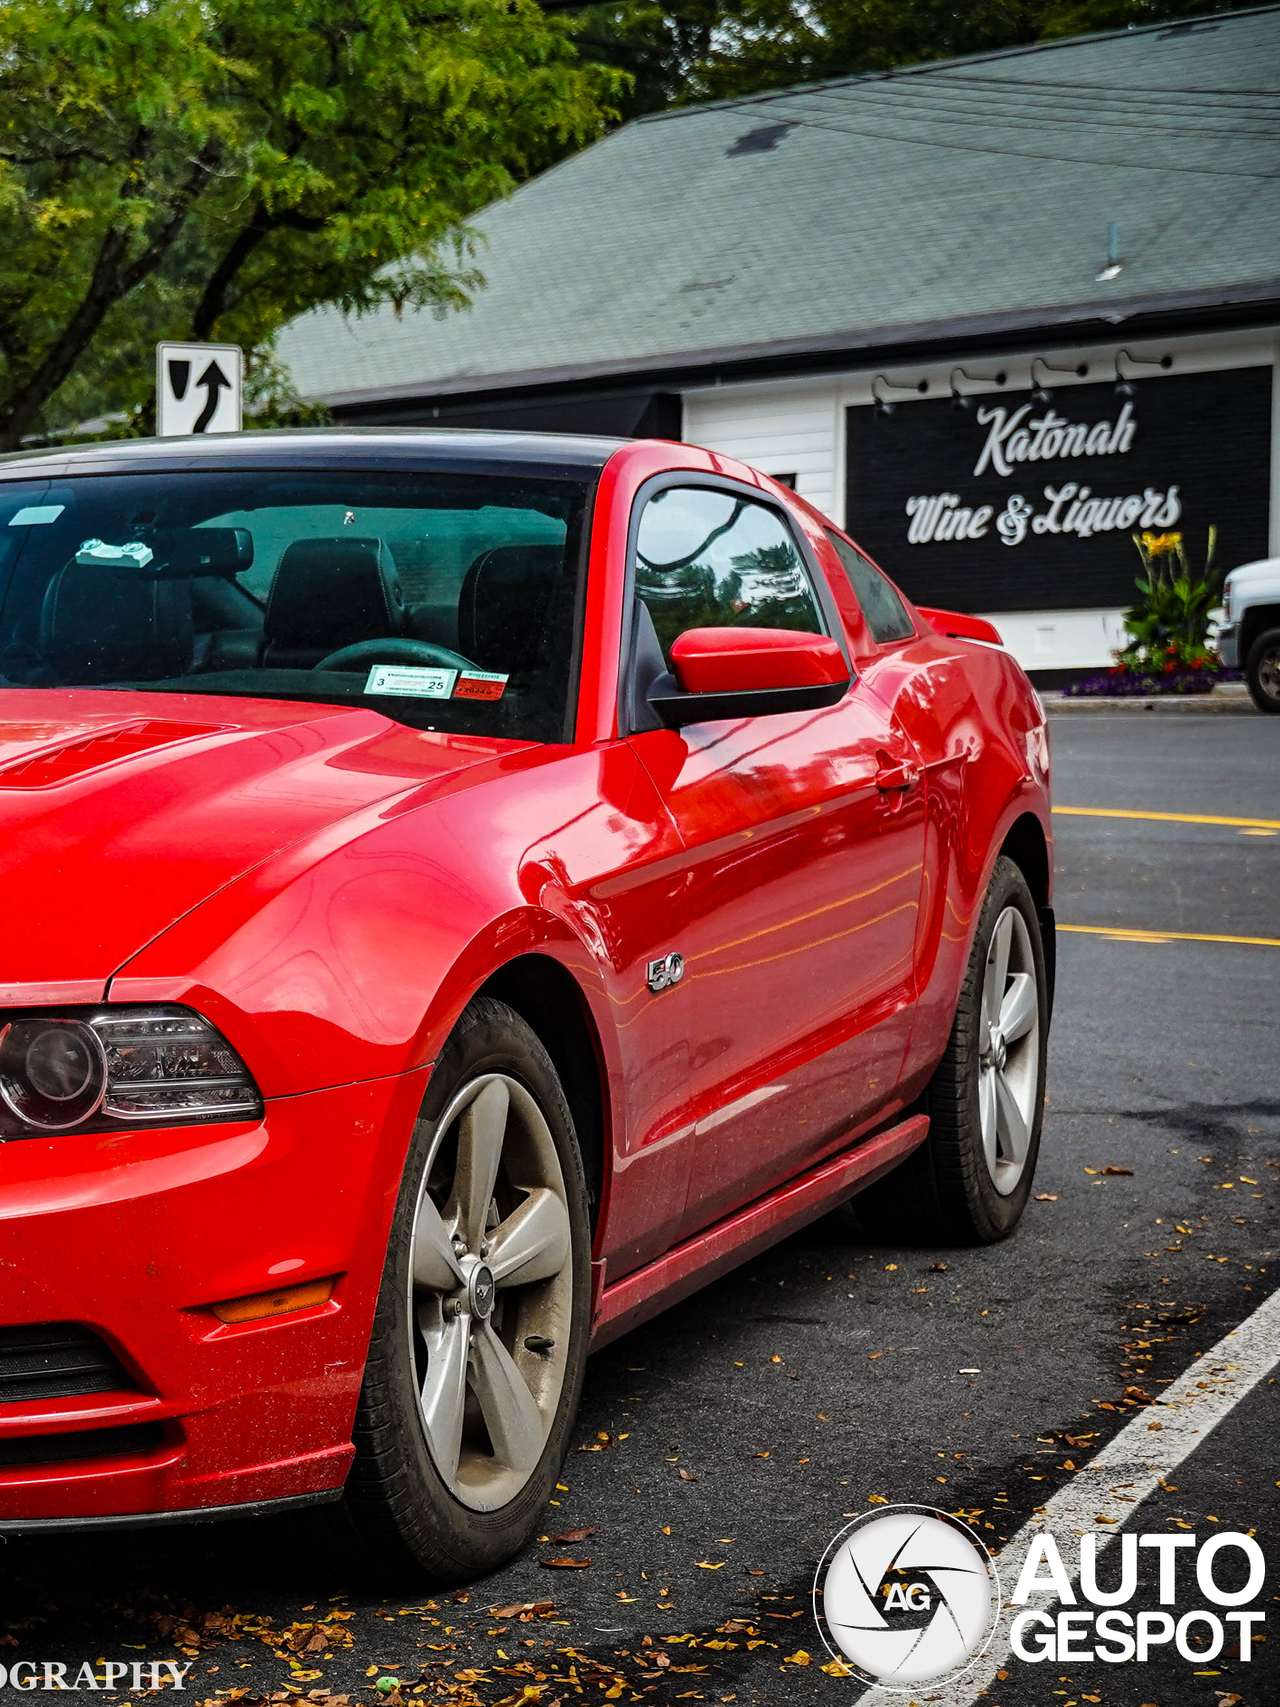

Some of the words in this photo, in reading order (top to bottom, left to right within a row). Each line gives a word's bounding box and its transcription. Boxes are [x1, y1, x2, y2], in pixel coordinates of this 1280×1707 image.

[973, 401, 1138, 477] Katonah
[905, 492, 994, 544] Wine
[996, 494, 1034, 546] &
[1032, 482, 1182, 538] Liquors
[428, 681, 444, 690] 25
